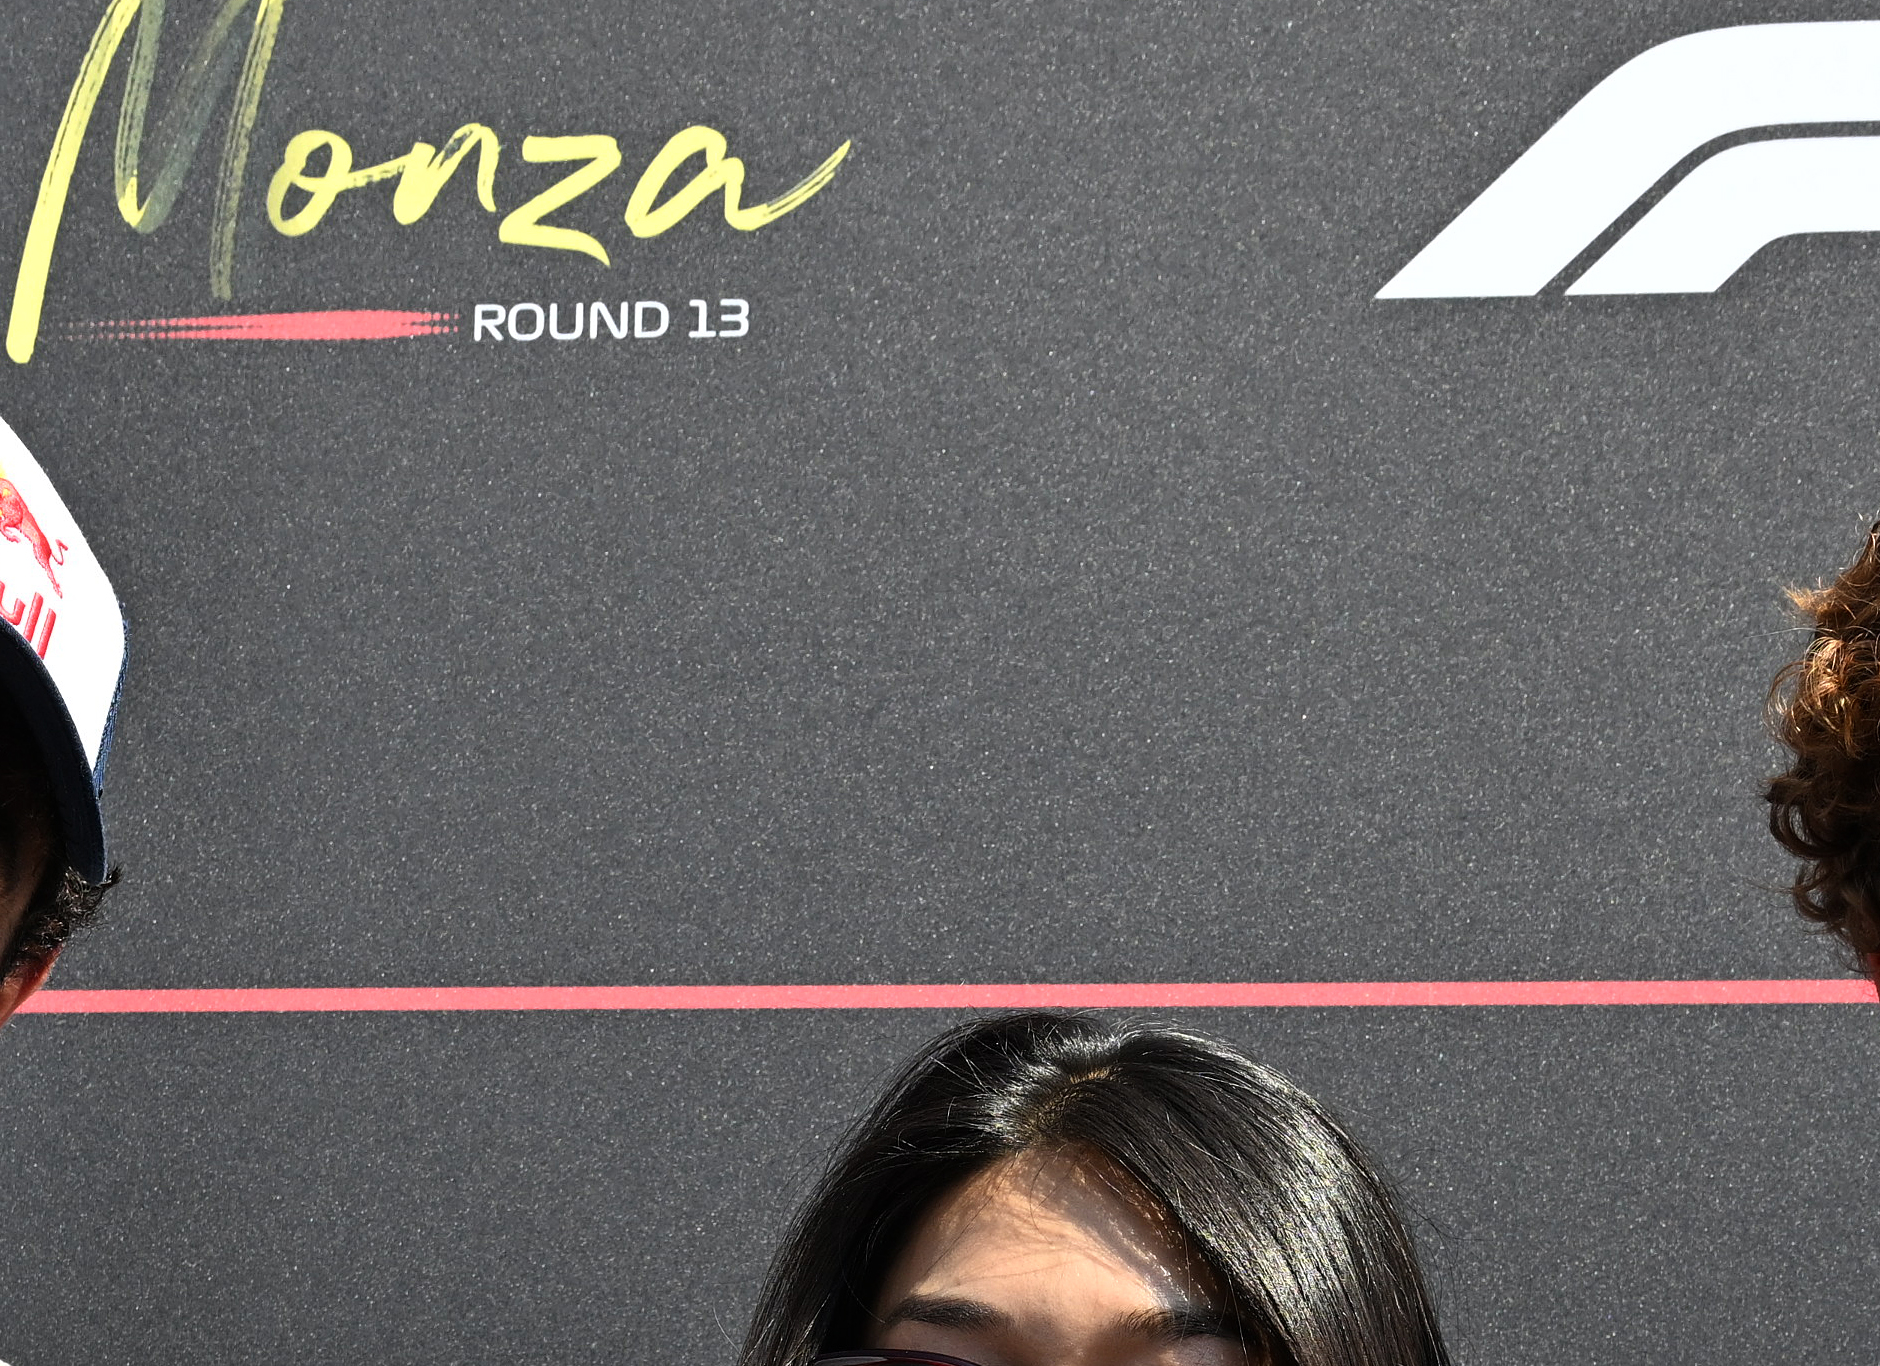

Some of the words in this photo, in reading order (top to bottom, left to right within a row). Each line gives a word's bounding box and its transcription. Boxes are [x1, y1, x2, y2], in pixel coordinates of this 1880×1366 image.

[5, 0, 851, 364] Monza
[472, 300, 670, 342] ROUND
[687, 298, 750, 338] 13
